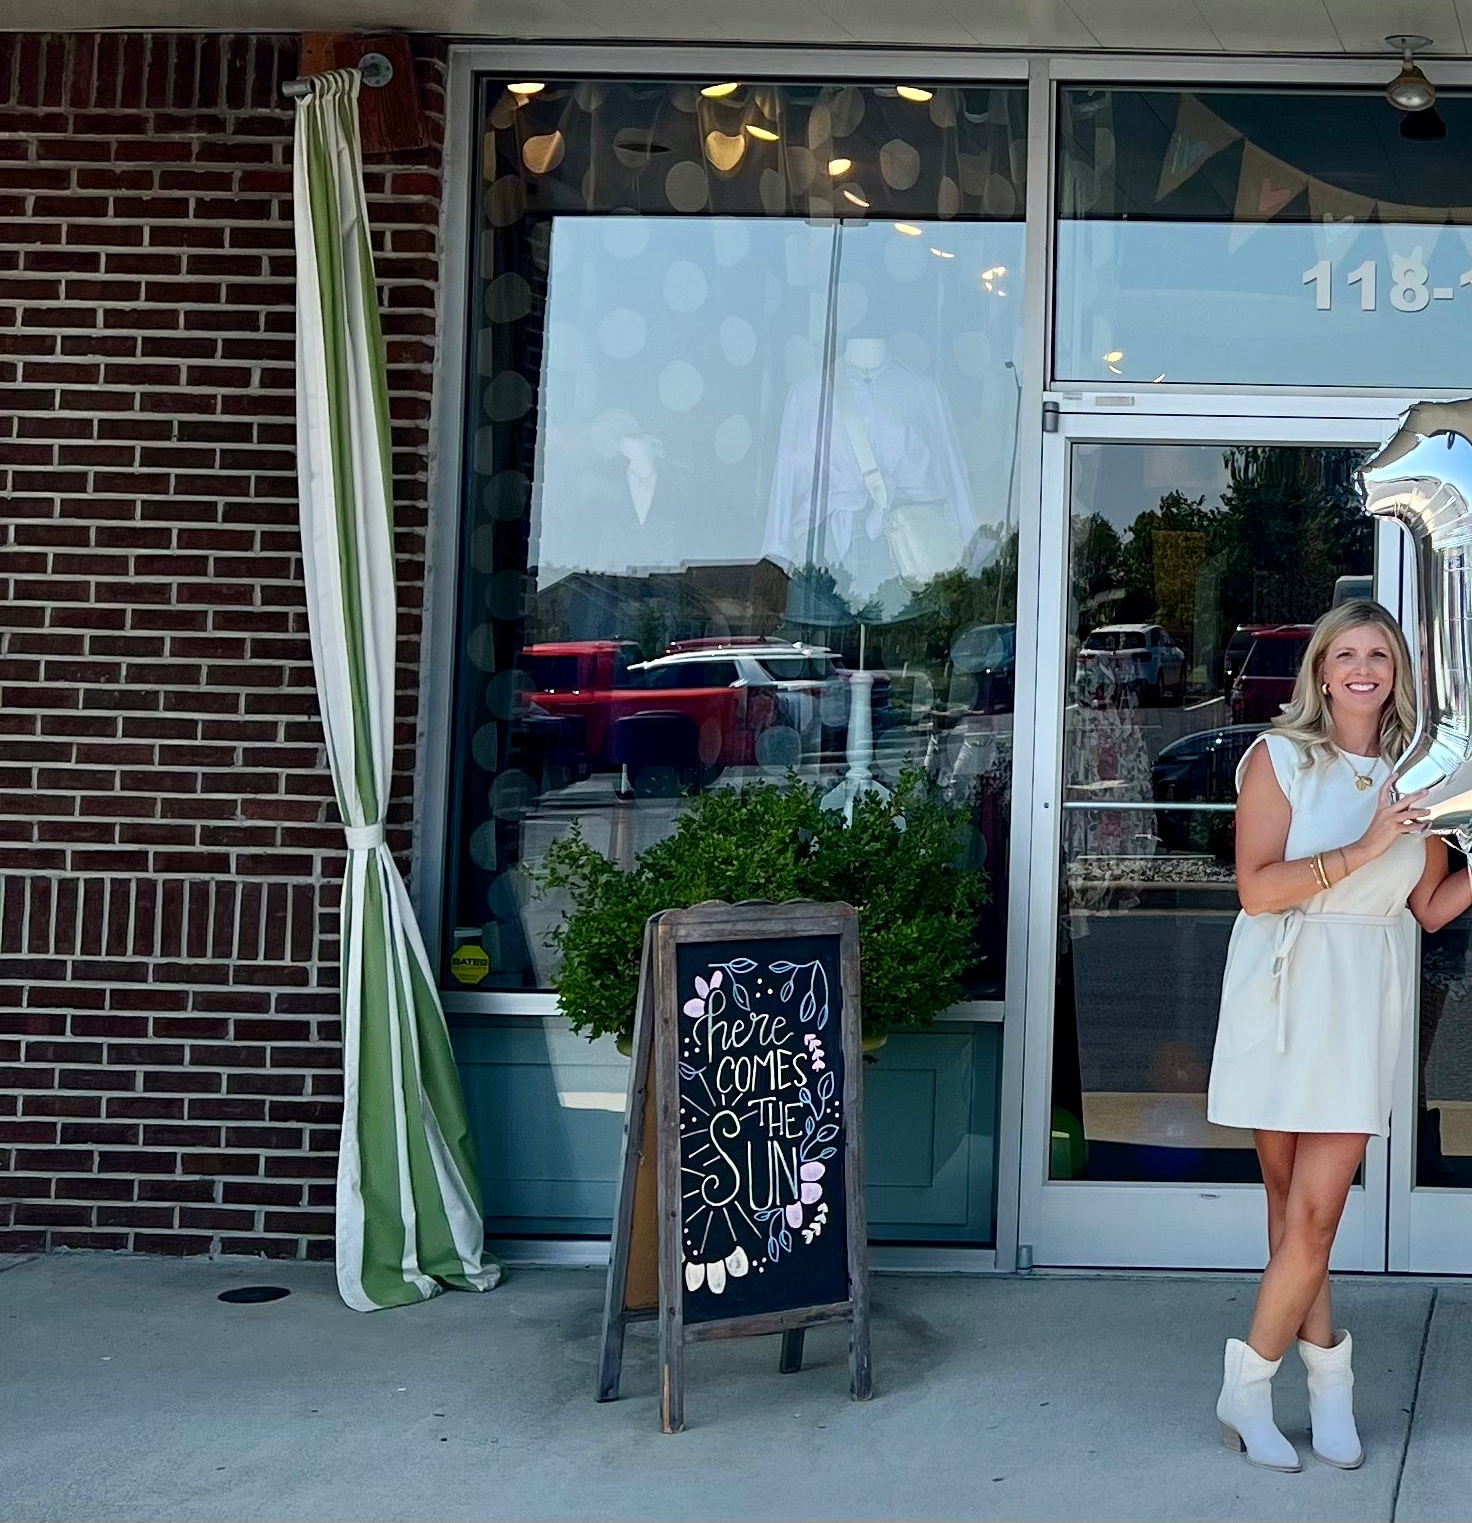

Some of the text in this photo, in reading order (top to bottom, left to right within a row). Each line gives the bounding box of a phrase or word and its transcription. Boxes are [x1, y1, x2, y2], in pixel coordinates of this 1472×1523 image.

[692, 989, 794, 1064] here
[716, 1049, 808, 1094] COMES
[747, 1095, 803, 1139] THE
[701, 1108, 802, 1212] SUN
